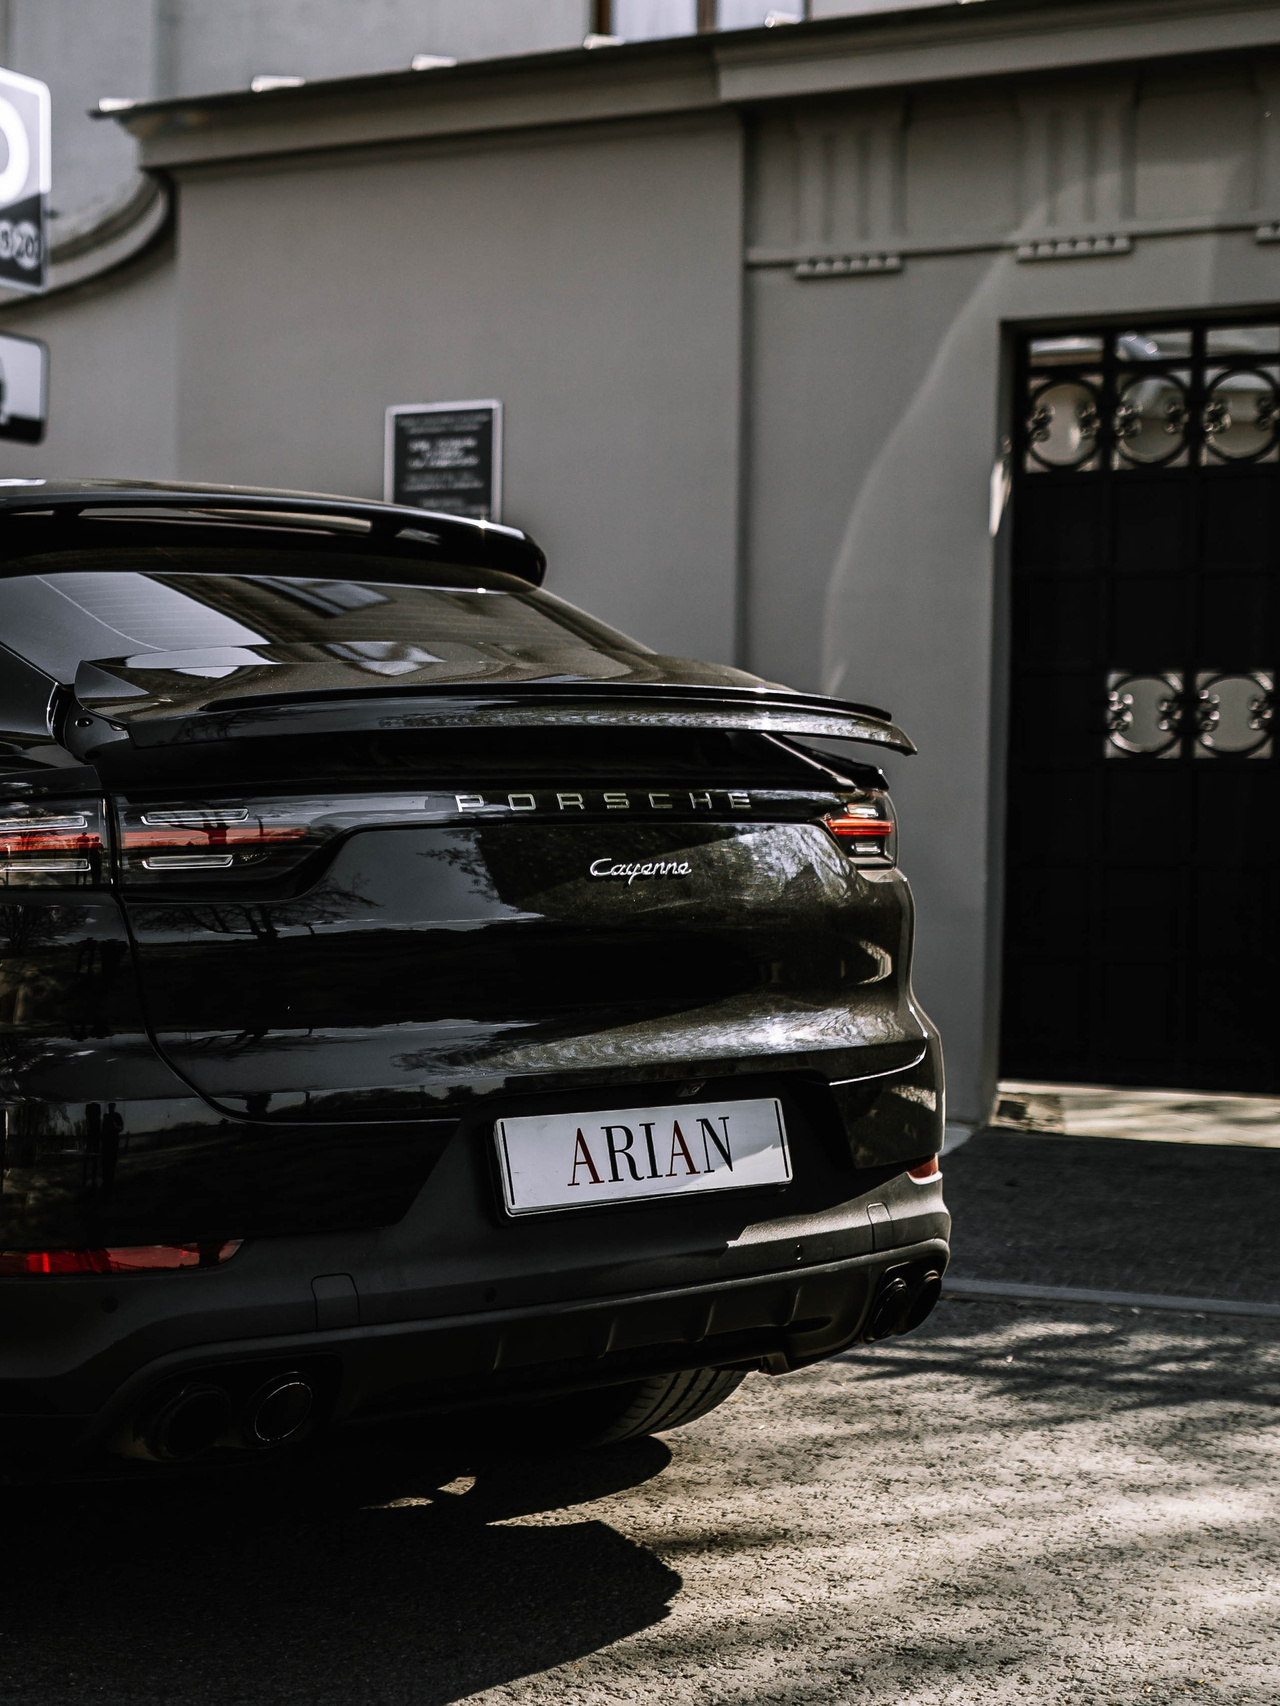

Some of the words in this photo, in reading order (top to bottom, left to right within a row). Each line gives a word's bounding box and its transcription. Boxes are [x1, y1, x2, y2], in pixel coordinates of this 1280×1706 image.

[455, 793, 752, 812] PORSCHE
[589, 858, 692, 885] Cayenne
[567, 1116, 734, 1187] ARIAN
